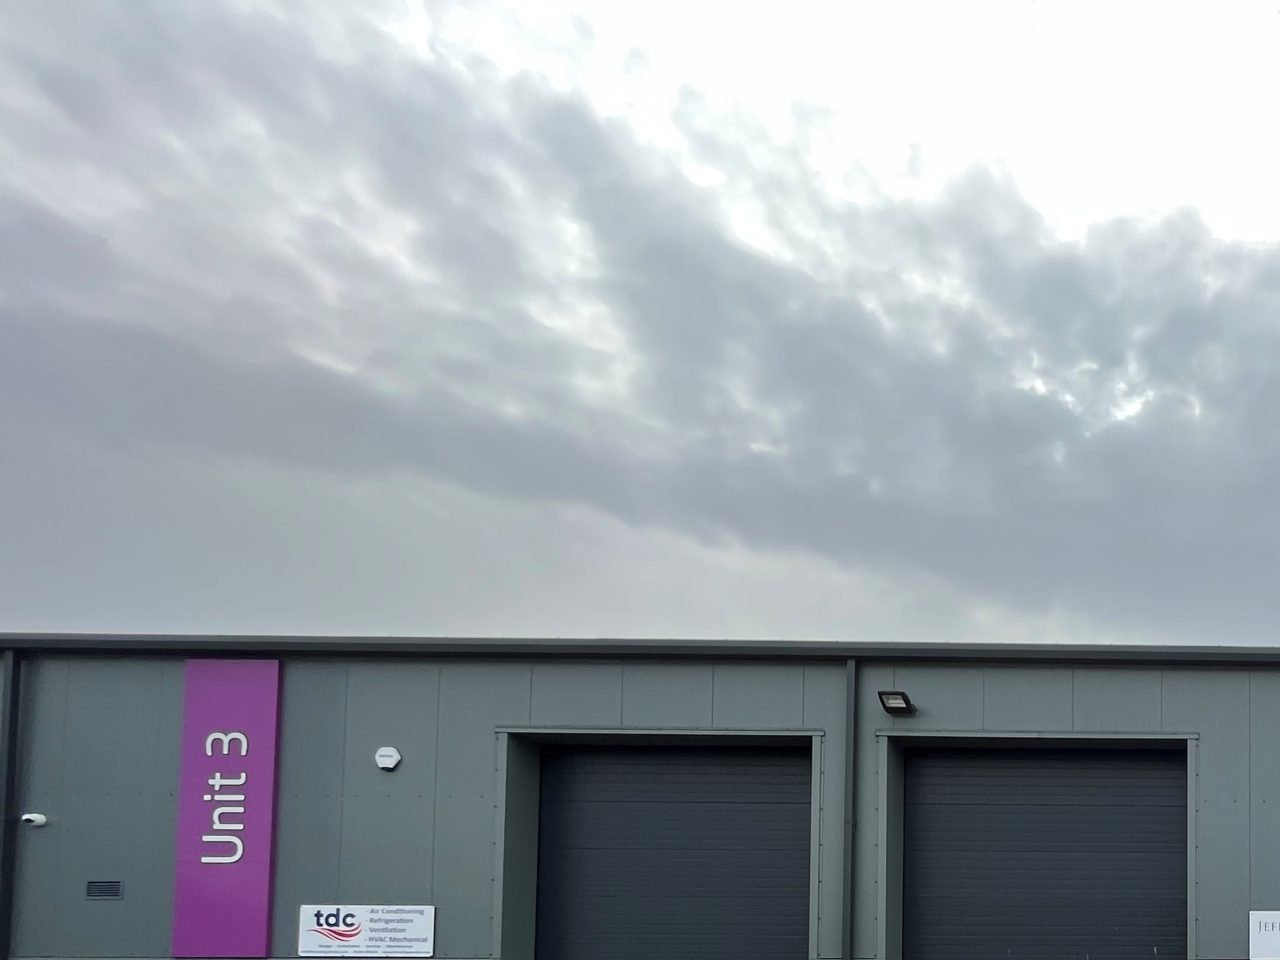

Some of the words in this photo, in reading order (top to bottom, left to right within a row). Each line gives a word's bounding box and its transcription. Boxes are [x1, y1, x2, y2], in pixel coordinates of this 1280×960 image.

[205, 732, 248, 756] 3
[201, 772, 247, 864] Unit
[314, 908, 356, 928] tdc
[369, 917, 414, 925] Refrigeration
[381, 908, 425, 916] Conditioning
